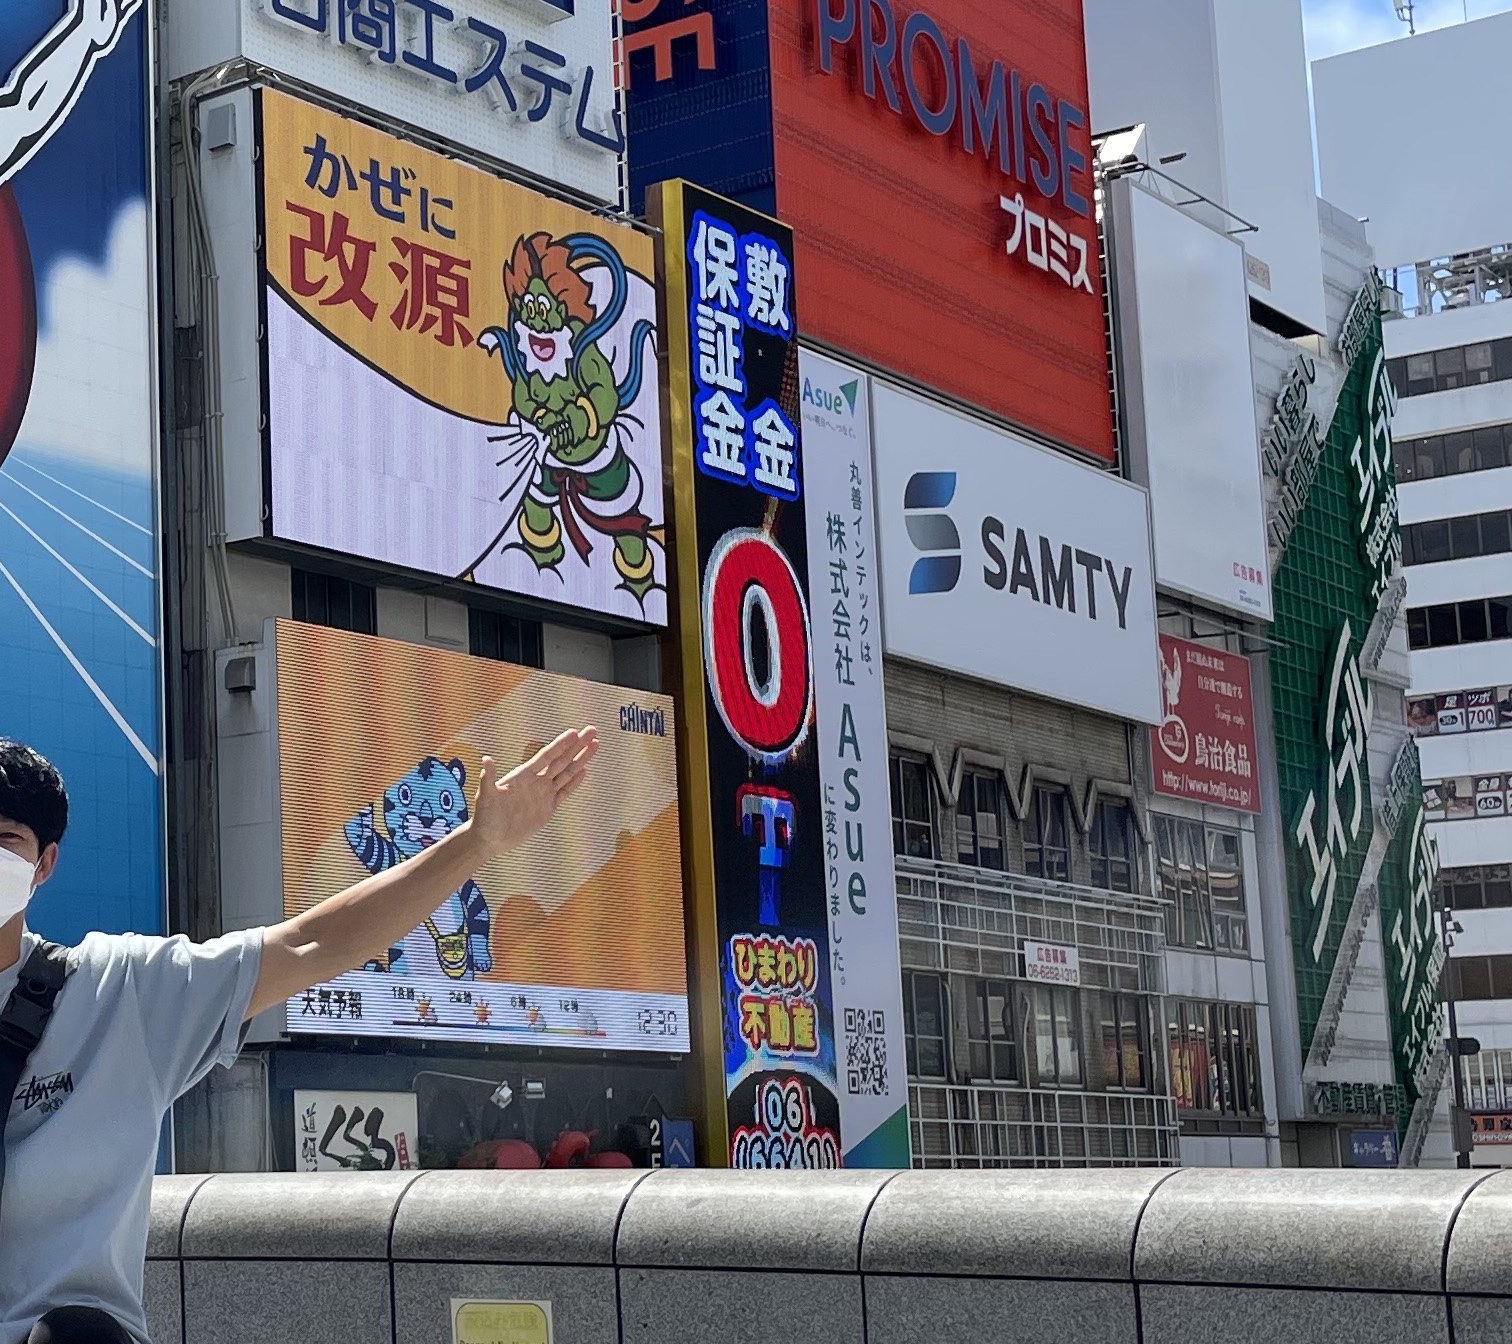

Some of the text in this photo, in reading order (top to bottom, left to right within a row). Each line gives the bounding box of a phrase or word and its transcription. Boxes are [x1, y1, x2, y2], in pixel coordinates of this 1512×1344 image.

[302, 134, 456, 240] かぜに
[998, 193, 1093, 294] プロミス
[285, 200, 475, 349] 改源
[693, 221, 747, 477] 保証金
[803, 377, 842, 416] Asue
[849, 460, 874, 676] 丸善インテックは、
[980, 516, 1133, 631] SAMTY
[826, 510, 868, 917] 株式会社 Asue
[1194, 732, 1252, 778] 鳥治食品
[1294, 618, 1374, 964] エイブル
[824, 782, 847, 986] に変わりました。
[1392, 805, 1440, 1014] エイブル
[734, 936, 817, 993] ひまわり
[741, 997, 818, 1052] 不動産
